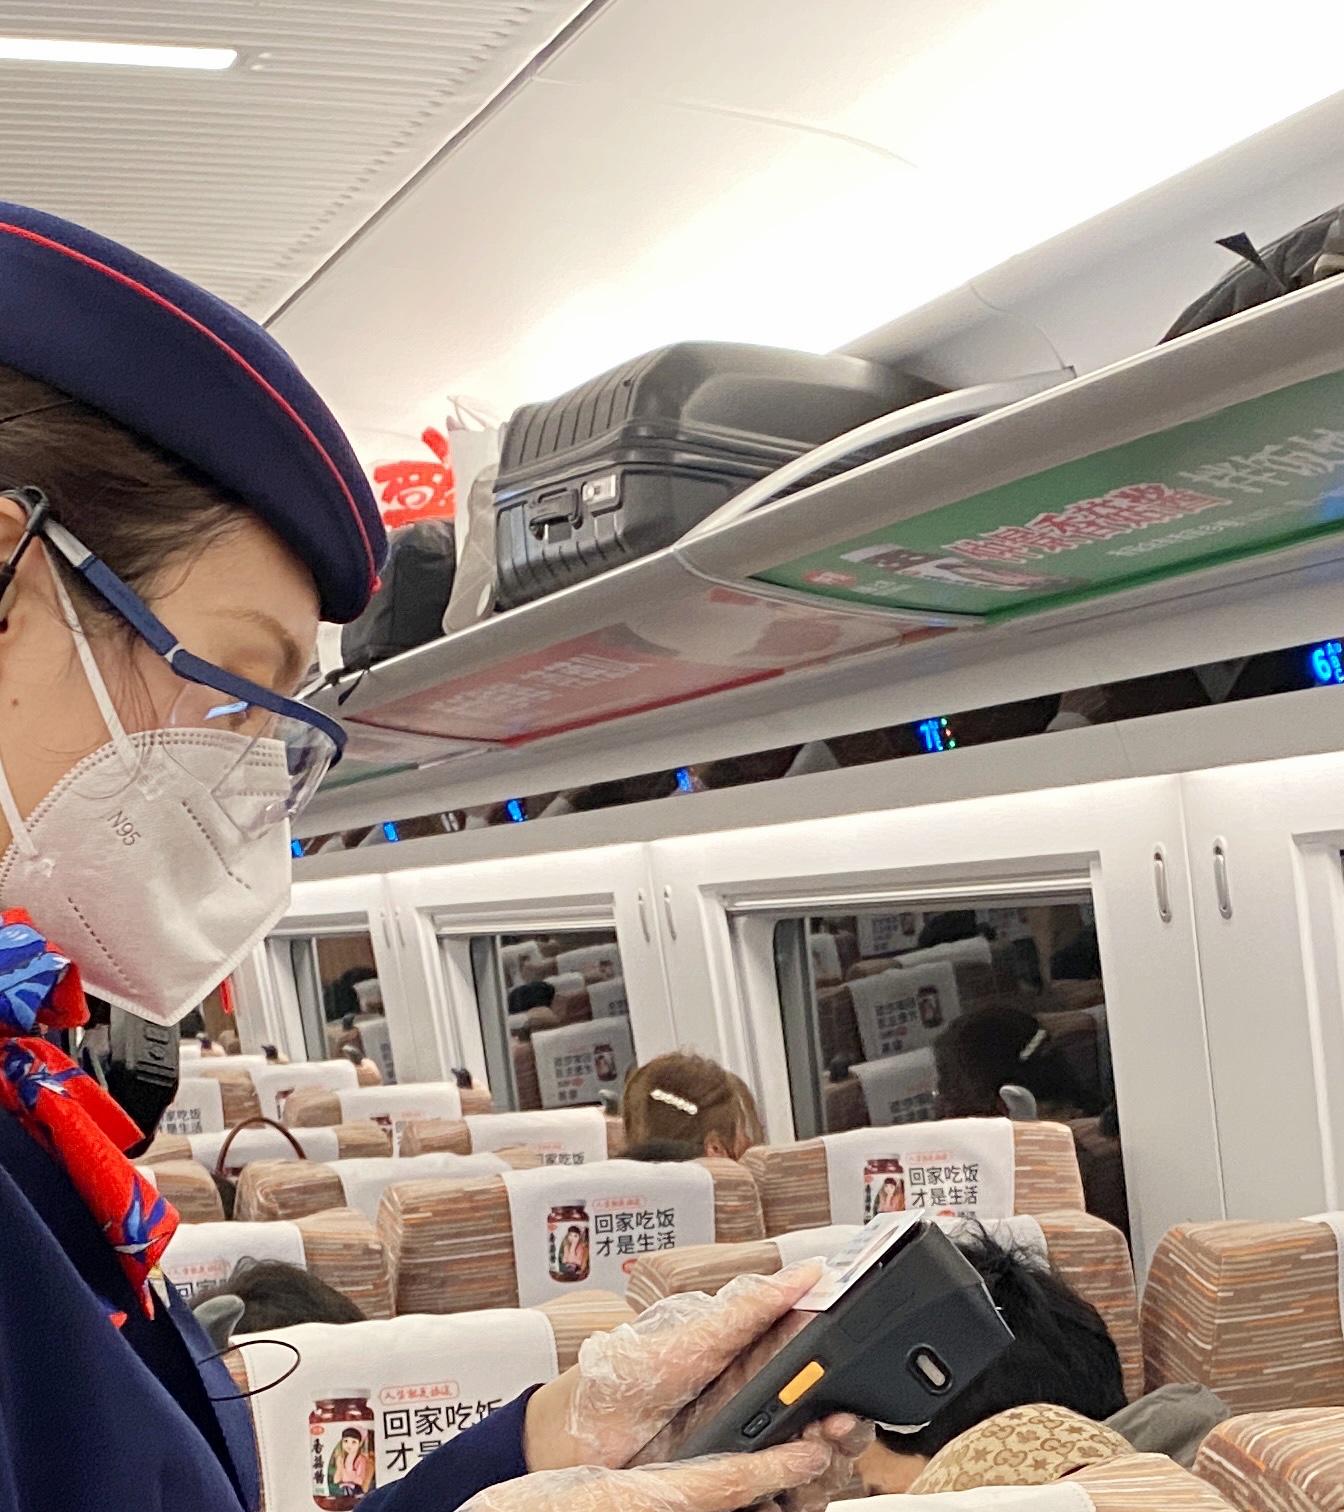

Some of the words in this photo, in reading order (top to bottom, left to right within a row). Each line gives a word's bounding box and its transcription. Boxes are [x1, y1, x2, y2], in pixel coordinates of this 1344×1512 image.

[1312, 648, 1331, 681] 6
[107, 810, 141, 846] N95
[909, 1163, 979, 1186] 回家吃饭
[911, 1185, 979, 1208] 才是生活
[594, 1207, 675, 1235] 回家吃饭
[596, 1230, 676, 1258] 才是生活
